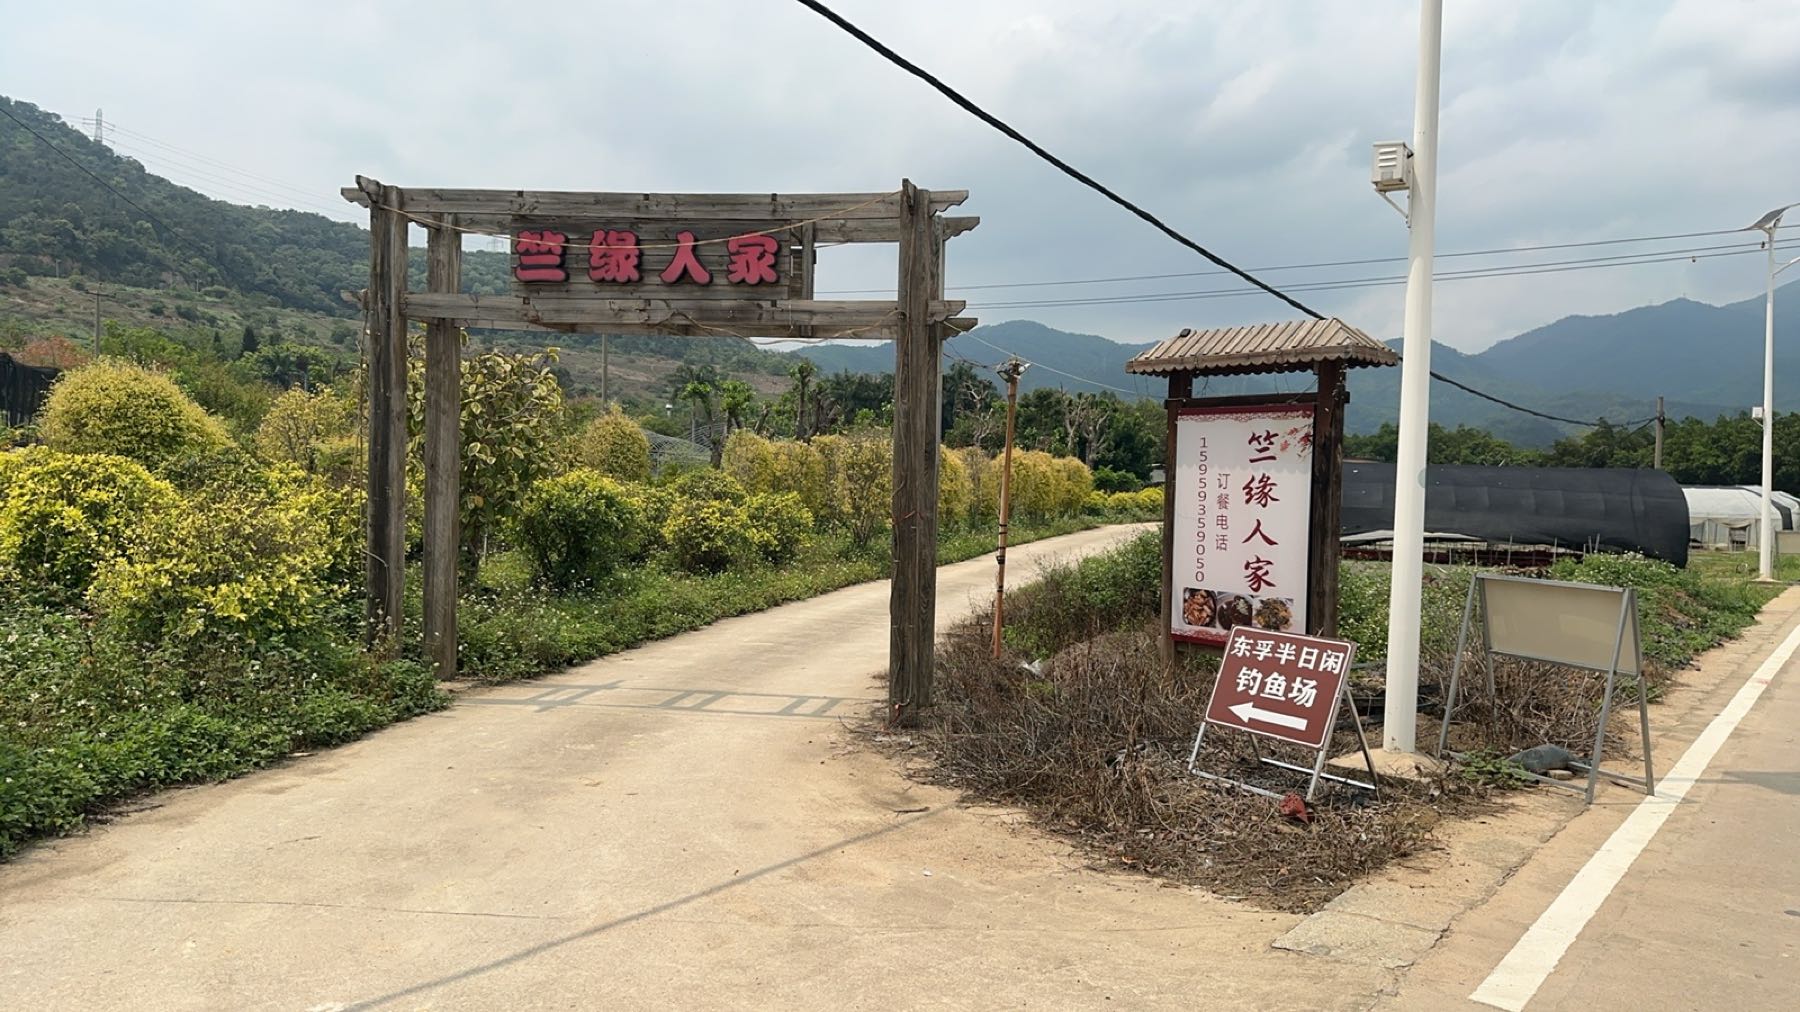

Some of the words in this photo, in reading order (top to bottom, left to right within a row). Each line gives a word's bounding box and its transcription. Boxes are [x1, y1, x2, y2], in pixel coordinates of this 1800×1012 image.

[515, 229, 779, 285] 竺缘人家
[1195, 436, 1208, 582] 15959359050
[1215, 473, 1231, 551] 订餐电话
[1242, 430, 1280, 593] 竺缘人家
[1230, 635, 1345, 675] 东孚半日闲
[1236, 666, 1318, 708] 钓鱼场
